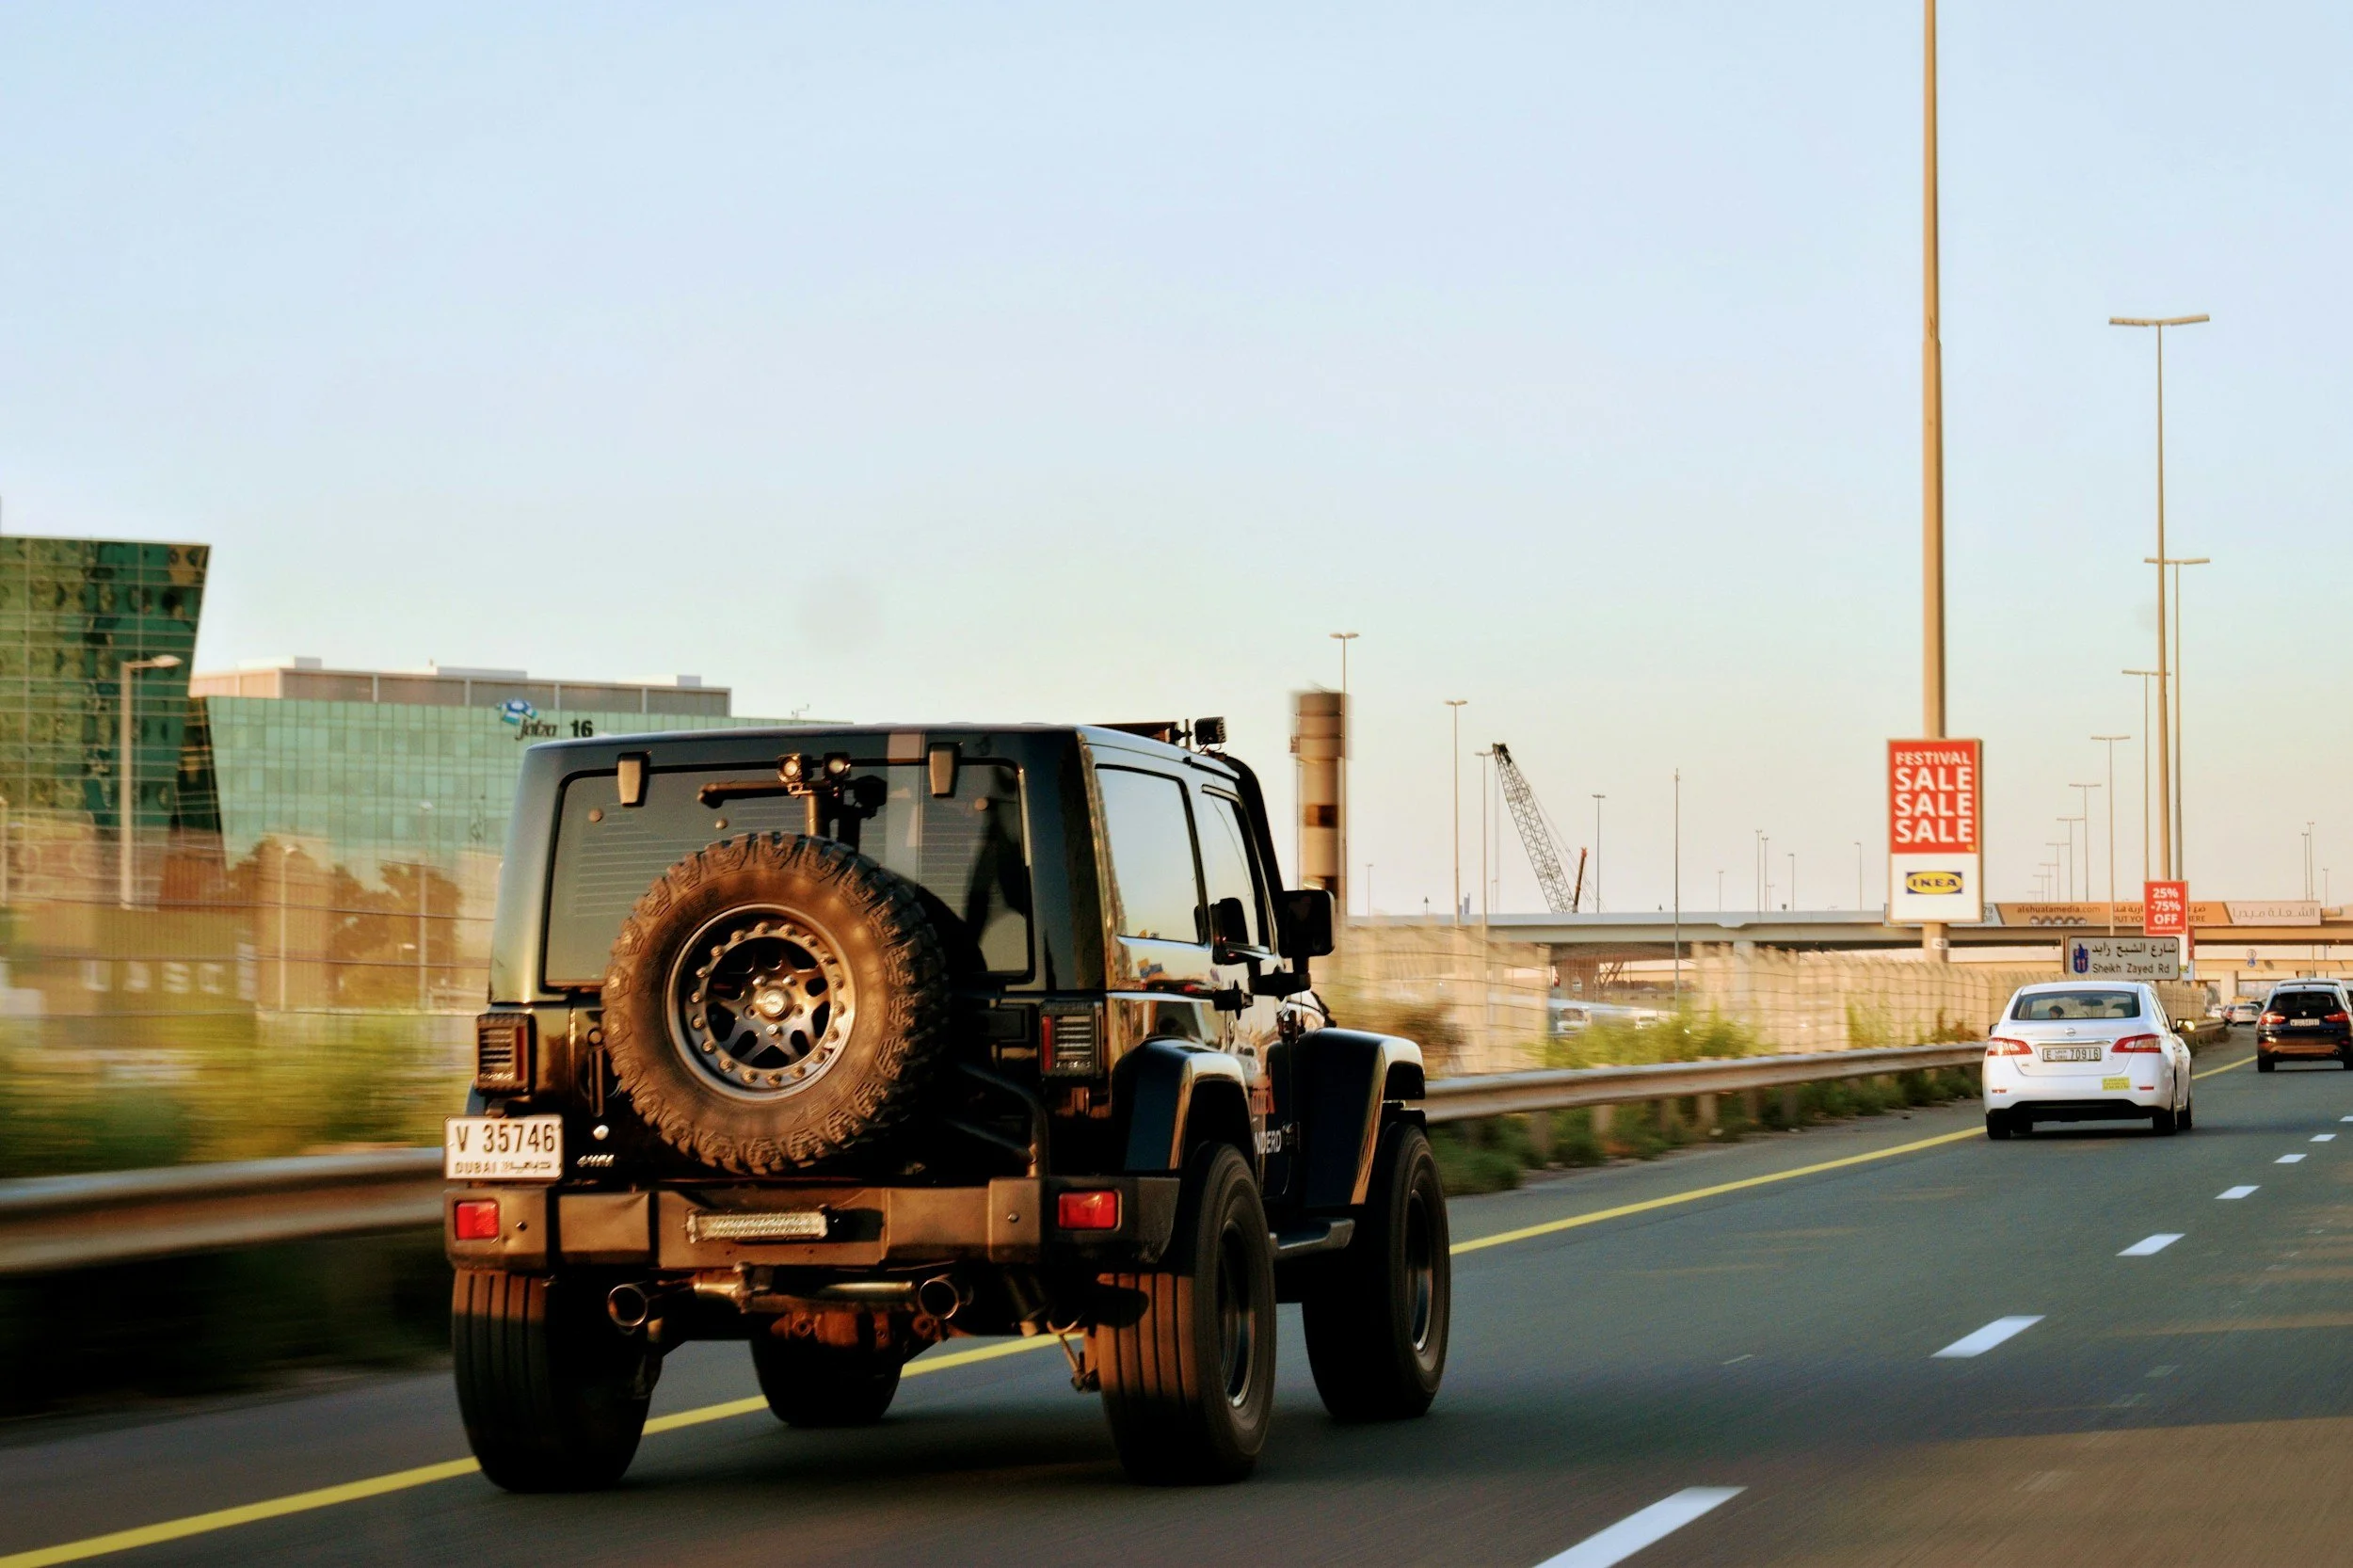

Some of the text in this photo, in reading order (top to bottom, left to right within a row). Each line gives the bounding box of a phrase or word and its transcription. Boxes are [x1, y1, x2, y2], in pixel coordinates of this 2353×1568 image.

[570, 719, 593, 737] 16
[1895, 751, 1972, 765] FESTIVAL
[1895, 767, 1972, 792] SALE
[1895, 792, 1972, 817] SALE
[1895, 819, 1973, 843] SALE
[1912, 878, 1958, 887] IKEA
[2153, 888, 2179, 899] 25%
[2151, 901, 2182, 912] -75%
[2153, 914, 2179, 925] OFF
[2116, 942, 2146, 957] الشيخ
[2151, 942, 2176, 957] شارع
[2092, 963, 2169, 975] Sheikh Zayed Rd
[456, 1123, 554, 1153] V 35746
[455, 1161, 497, 1174] DUBAI
